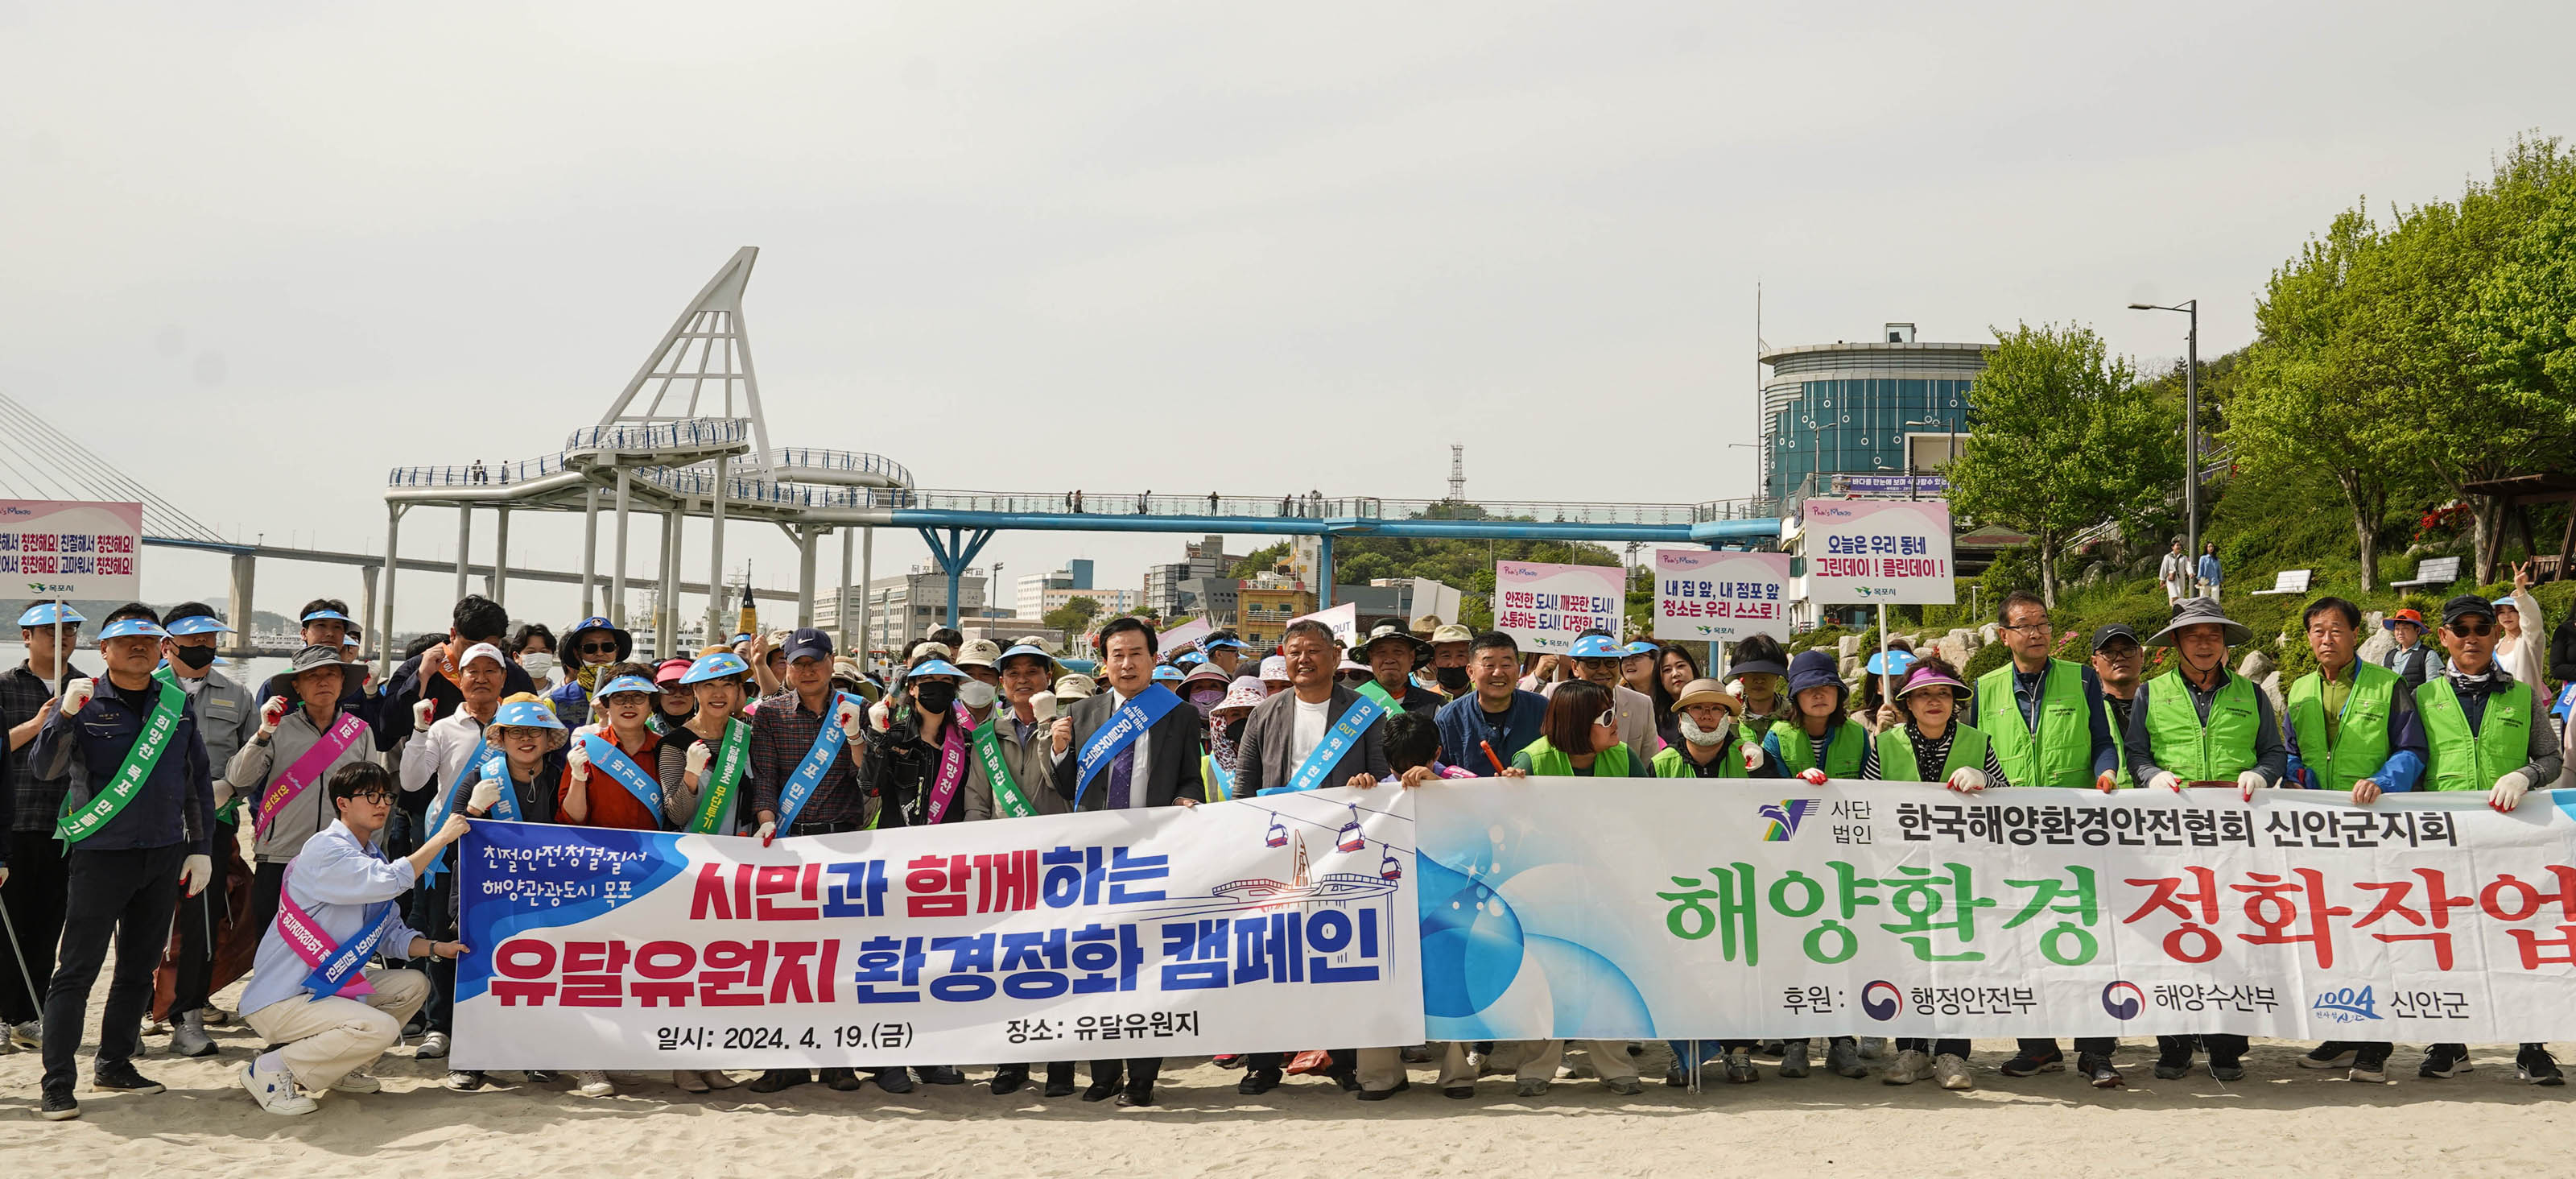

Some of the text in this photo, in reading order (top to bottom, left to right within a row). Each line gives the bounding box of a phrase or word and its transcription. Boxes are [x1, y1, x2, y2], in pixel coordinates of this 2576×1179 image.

[21, 534, 59, 552] 칭찬해요!
[61, 534, 95, 552] 친절해서
[97, 536, 134, 553] 칭찬해요!
[1828, 535, 1926, 556] 오늘은 우리 동네
[21, 556, 58, 574] 칭찬해요!
[60, 556, 94, 574] 고마워서
[97, 557, 133, 575] 칭찬해요!
[1505, 591, 1614, 614] 안전한 도시! 깨끗한 도시!
[1666, 580, 1780, 600] 내 집 앞, 내 점포 앞
[1874, 588, 1896, 596] 목포시
[1500, 610, 1537, 629] 소통하는
[1538, 614, 1561, 631] 도시!
[1563, 614, 1592, 632] 다정한
[1662, 599, 1702, 617] 청소는
[1705, 602, 1730, 618] 우리
[1333, 621, 1352, 635] OUT
[1550, 639, 1569, 647] 목포시
[1132, 705, 1149, 722] 시민과
[138, 714, 171, 760] 희망찬
[1083, 718, 1133, 769] 유달유원지
[1339, 722, 1357, 738] OUT
[612, 759, 646, 790] 바가지
[777, 714, 842, 829] 망찬 목포 만들기
[940, 749, 960, 795] 희망찬
[982, 743, 1005, 786] 희망찬
[114, 764, 142, 797] 목포
[264, 784, 290, 813] 안전한
[1831, 800, 1872, 821] 사단
[68, 800, 114, 834] 만들기
[1896, 802, 2458, 849] 한국해양환경안전협회 신안군지회
[1831, 824, 1872, 845] 법인
[481, 879, 634, 908] 해양관광도시 목포
[689, 846, 1170, 921] 시민과 함께하는
[1655, 861, 2576, 971] 해양환경 정화작업
[283, 912, 324, 955] 환경정화
[325, 950, 358, 983] 캠페인
[490, 908, 1380, 1008] 유달유원지 환경정화 캠페인
[1909, 986, 2037, 1016] 행정안전부
[2153, 982, 2279, 1014] 해양수산부
[2313, 985, 2376, 1018] 1004
[2390, 991, 2470, 1020] 신안군
[657, 1027, 714, 1051] 일시:
[724, 1027, 790, 1050] 2024.
[799, 1027, 822, 1049] 4.
[1006, 1010, 1199, 1045] 장소: 유달유원지
